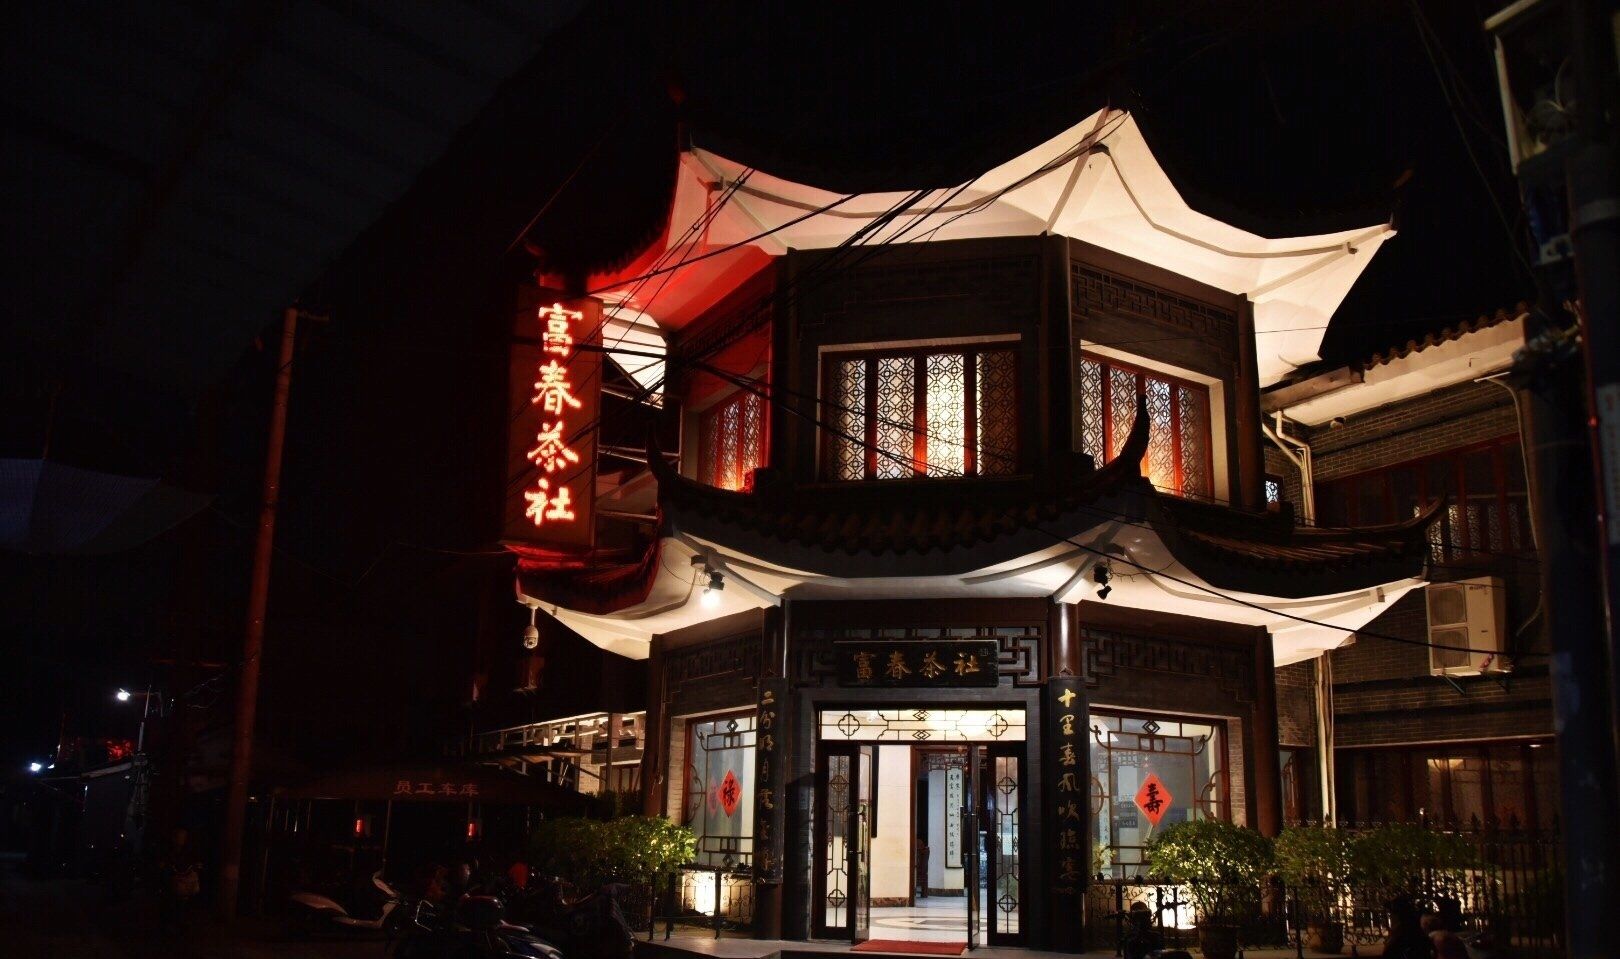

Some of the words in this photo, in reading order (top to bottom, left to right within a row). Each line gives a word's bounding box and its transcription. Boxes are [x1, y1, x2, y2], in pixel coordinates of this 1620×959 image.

[525, 303, 583, 526] 富春茶社
[853, 650, 981, 682] 富春茶社
[393, 780, 480, 797] 员工车库
